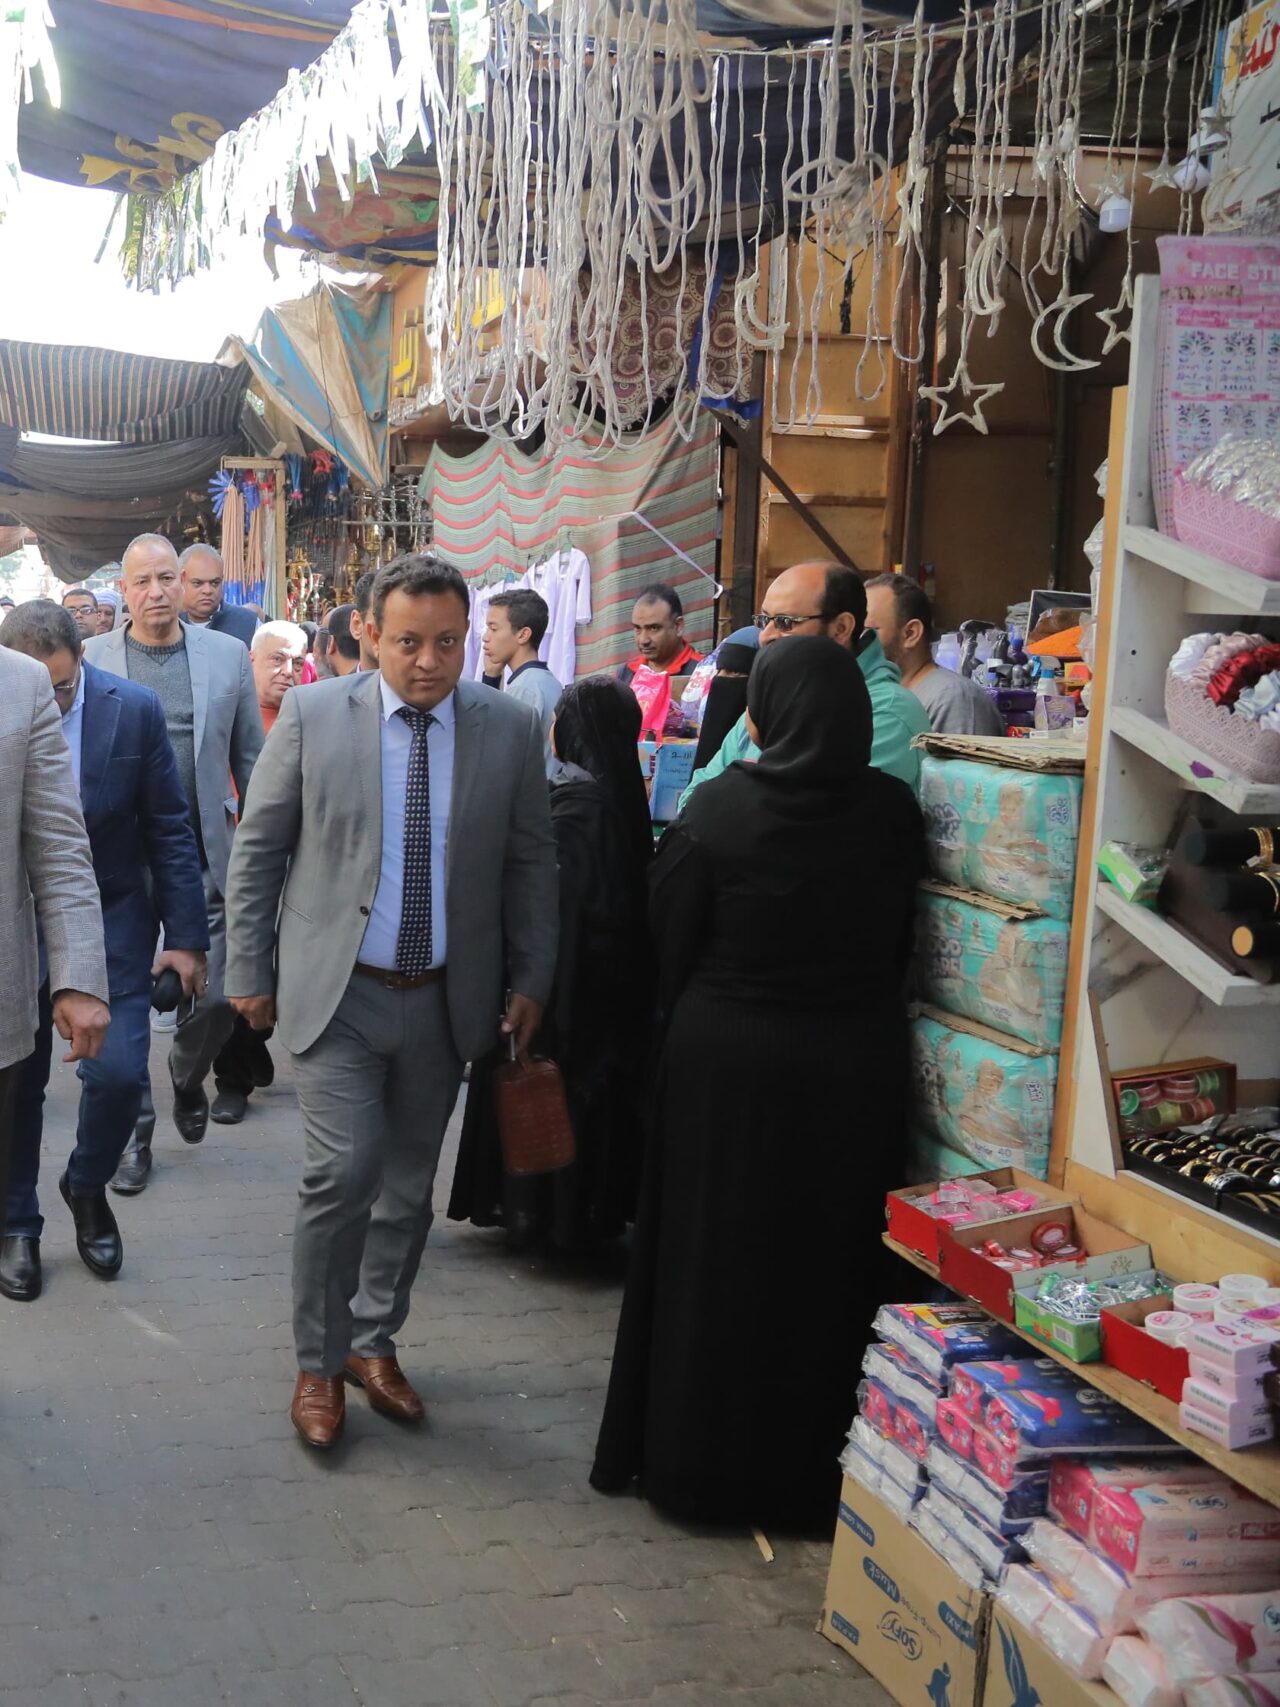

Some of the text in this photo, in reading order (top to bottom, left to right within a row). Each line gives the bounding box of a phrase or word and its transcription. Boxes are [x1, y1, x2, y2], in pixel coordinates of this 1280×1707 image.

[1191, 262, 1240, 279] FACE
[868, 1562, 898, 1599] Musk
[880, 1615, 919, 1657] SOFY
